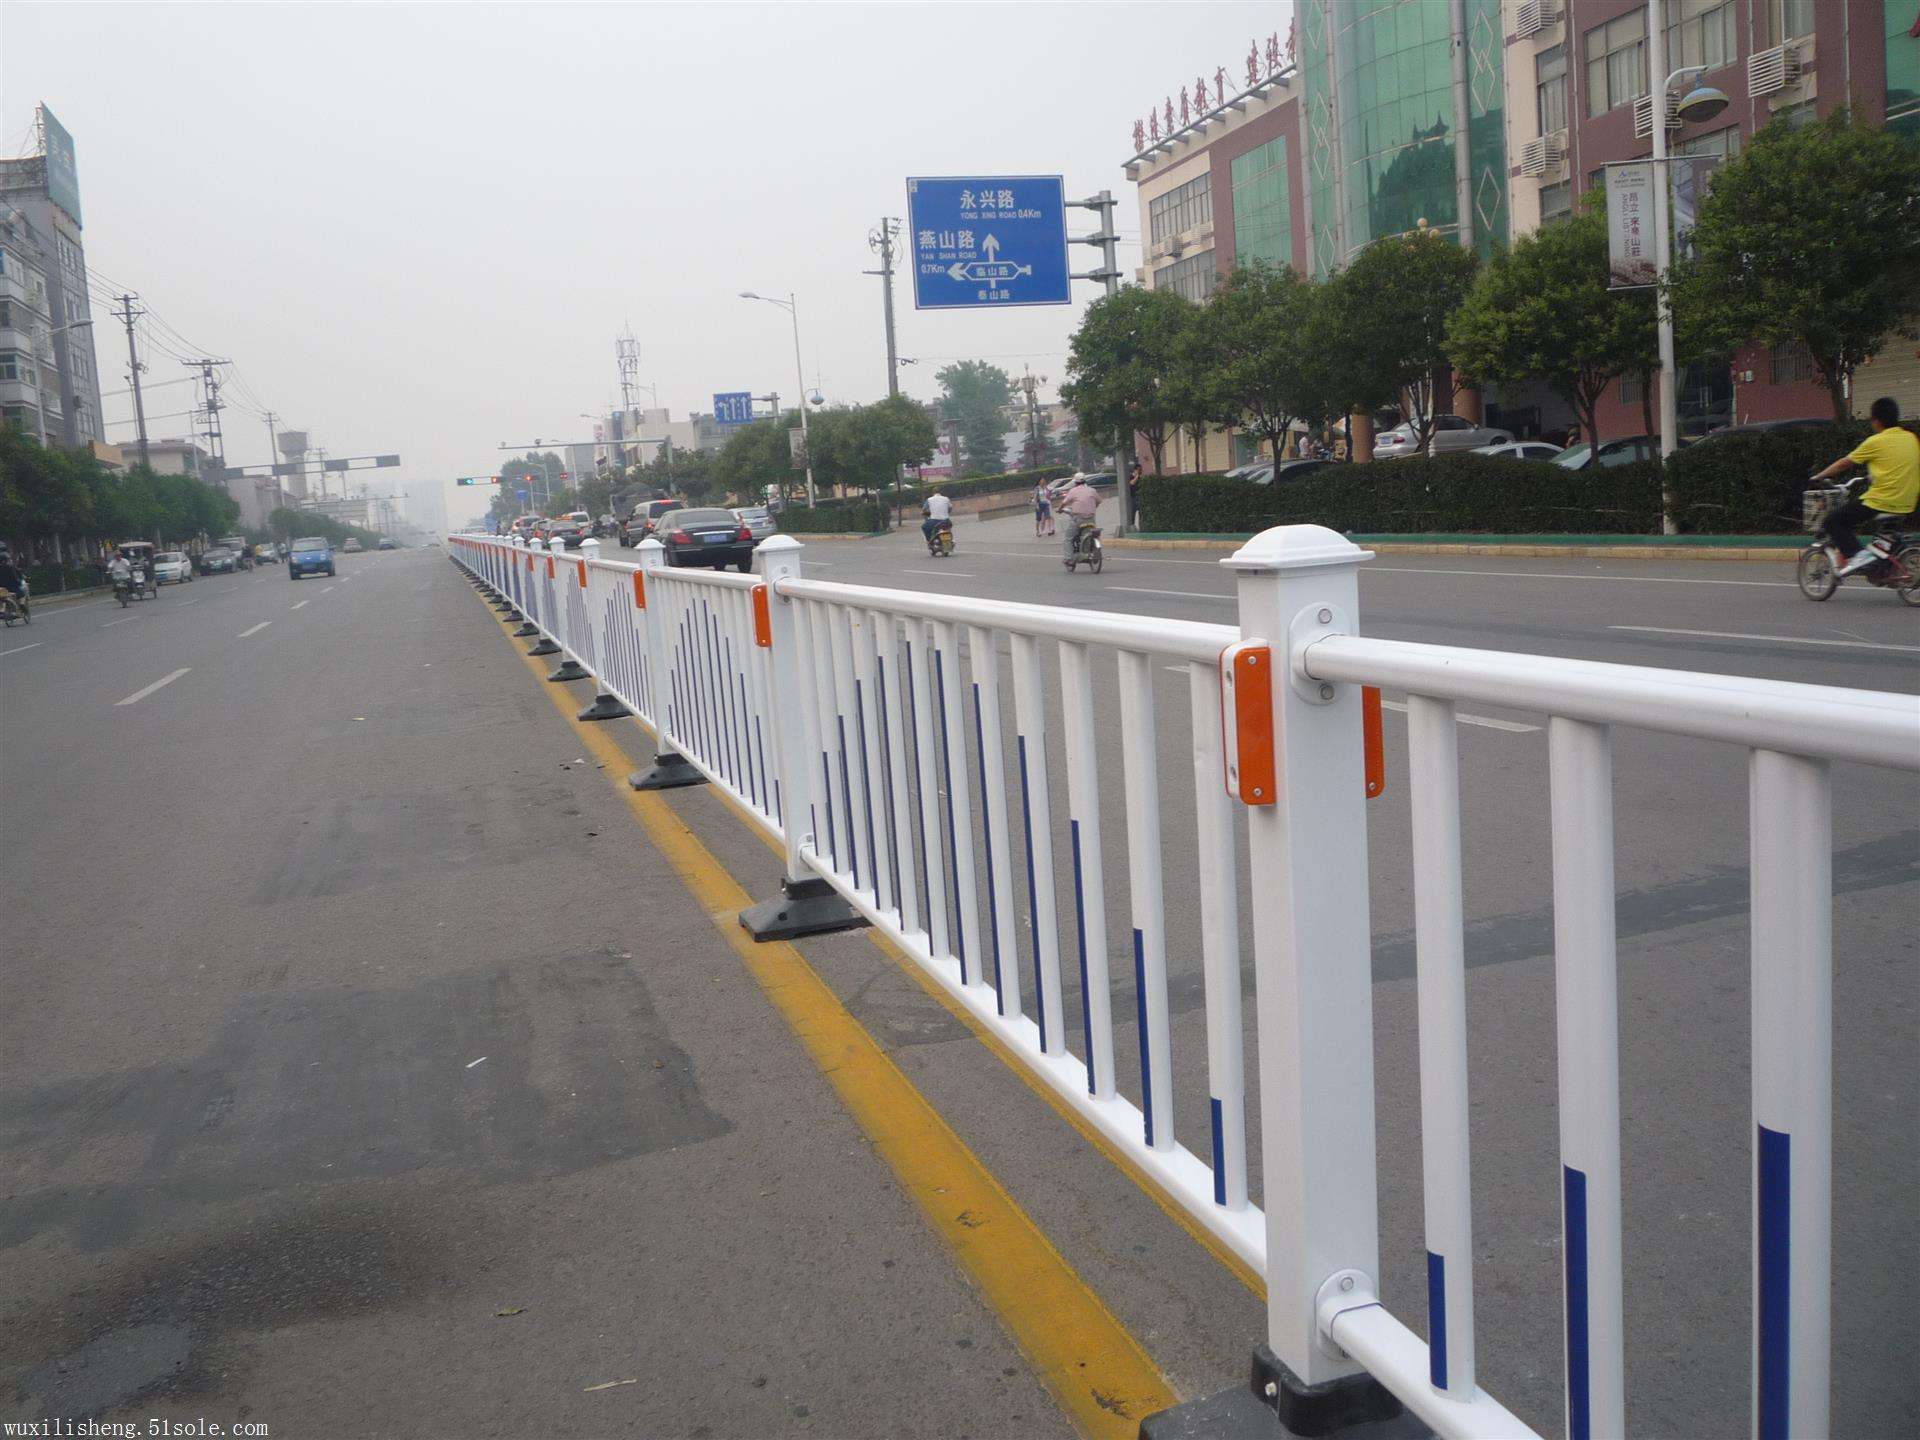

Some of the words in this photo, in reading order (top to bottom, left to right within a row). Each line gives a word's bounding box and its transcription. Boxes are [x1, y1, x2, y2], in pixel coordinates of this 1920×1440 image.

[960, 189, 1014, 209] 永兴路
[919, 230, 975, 249] 燕山路
